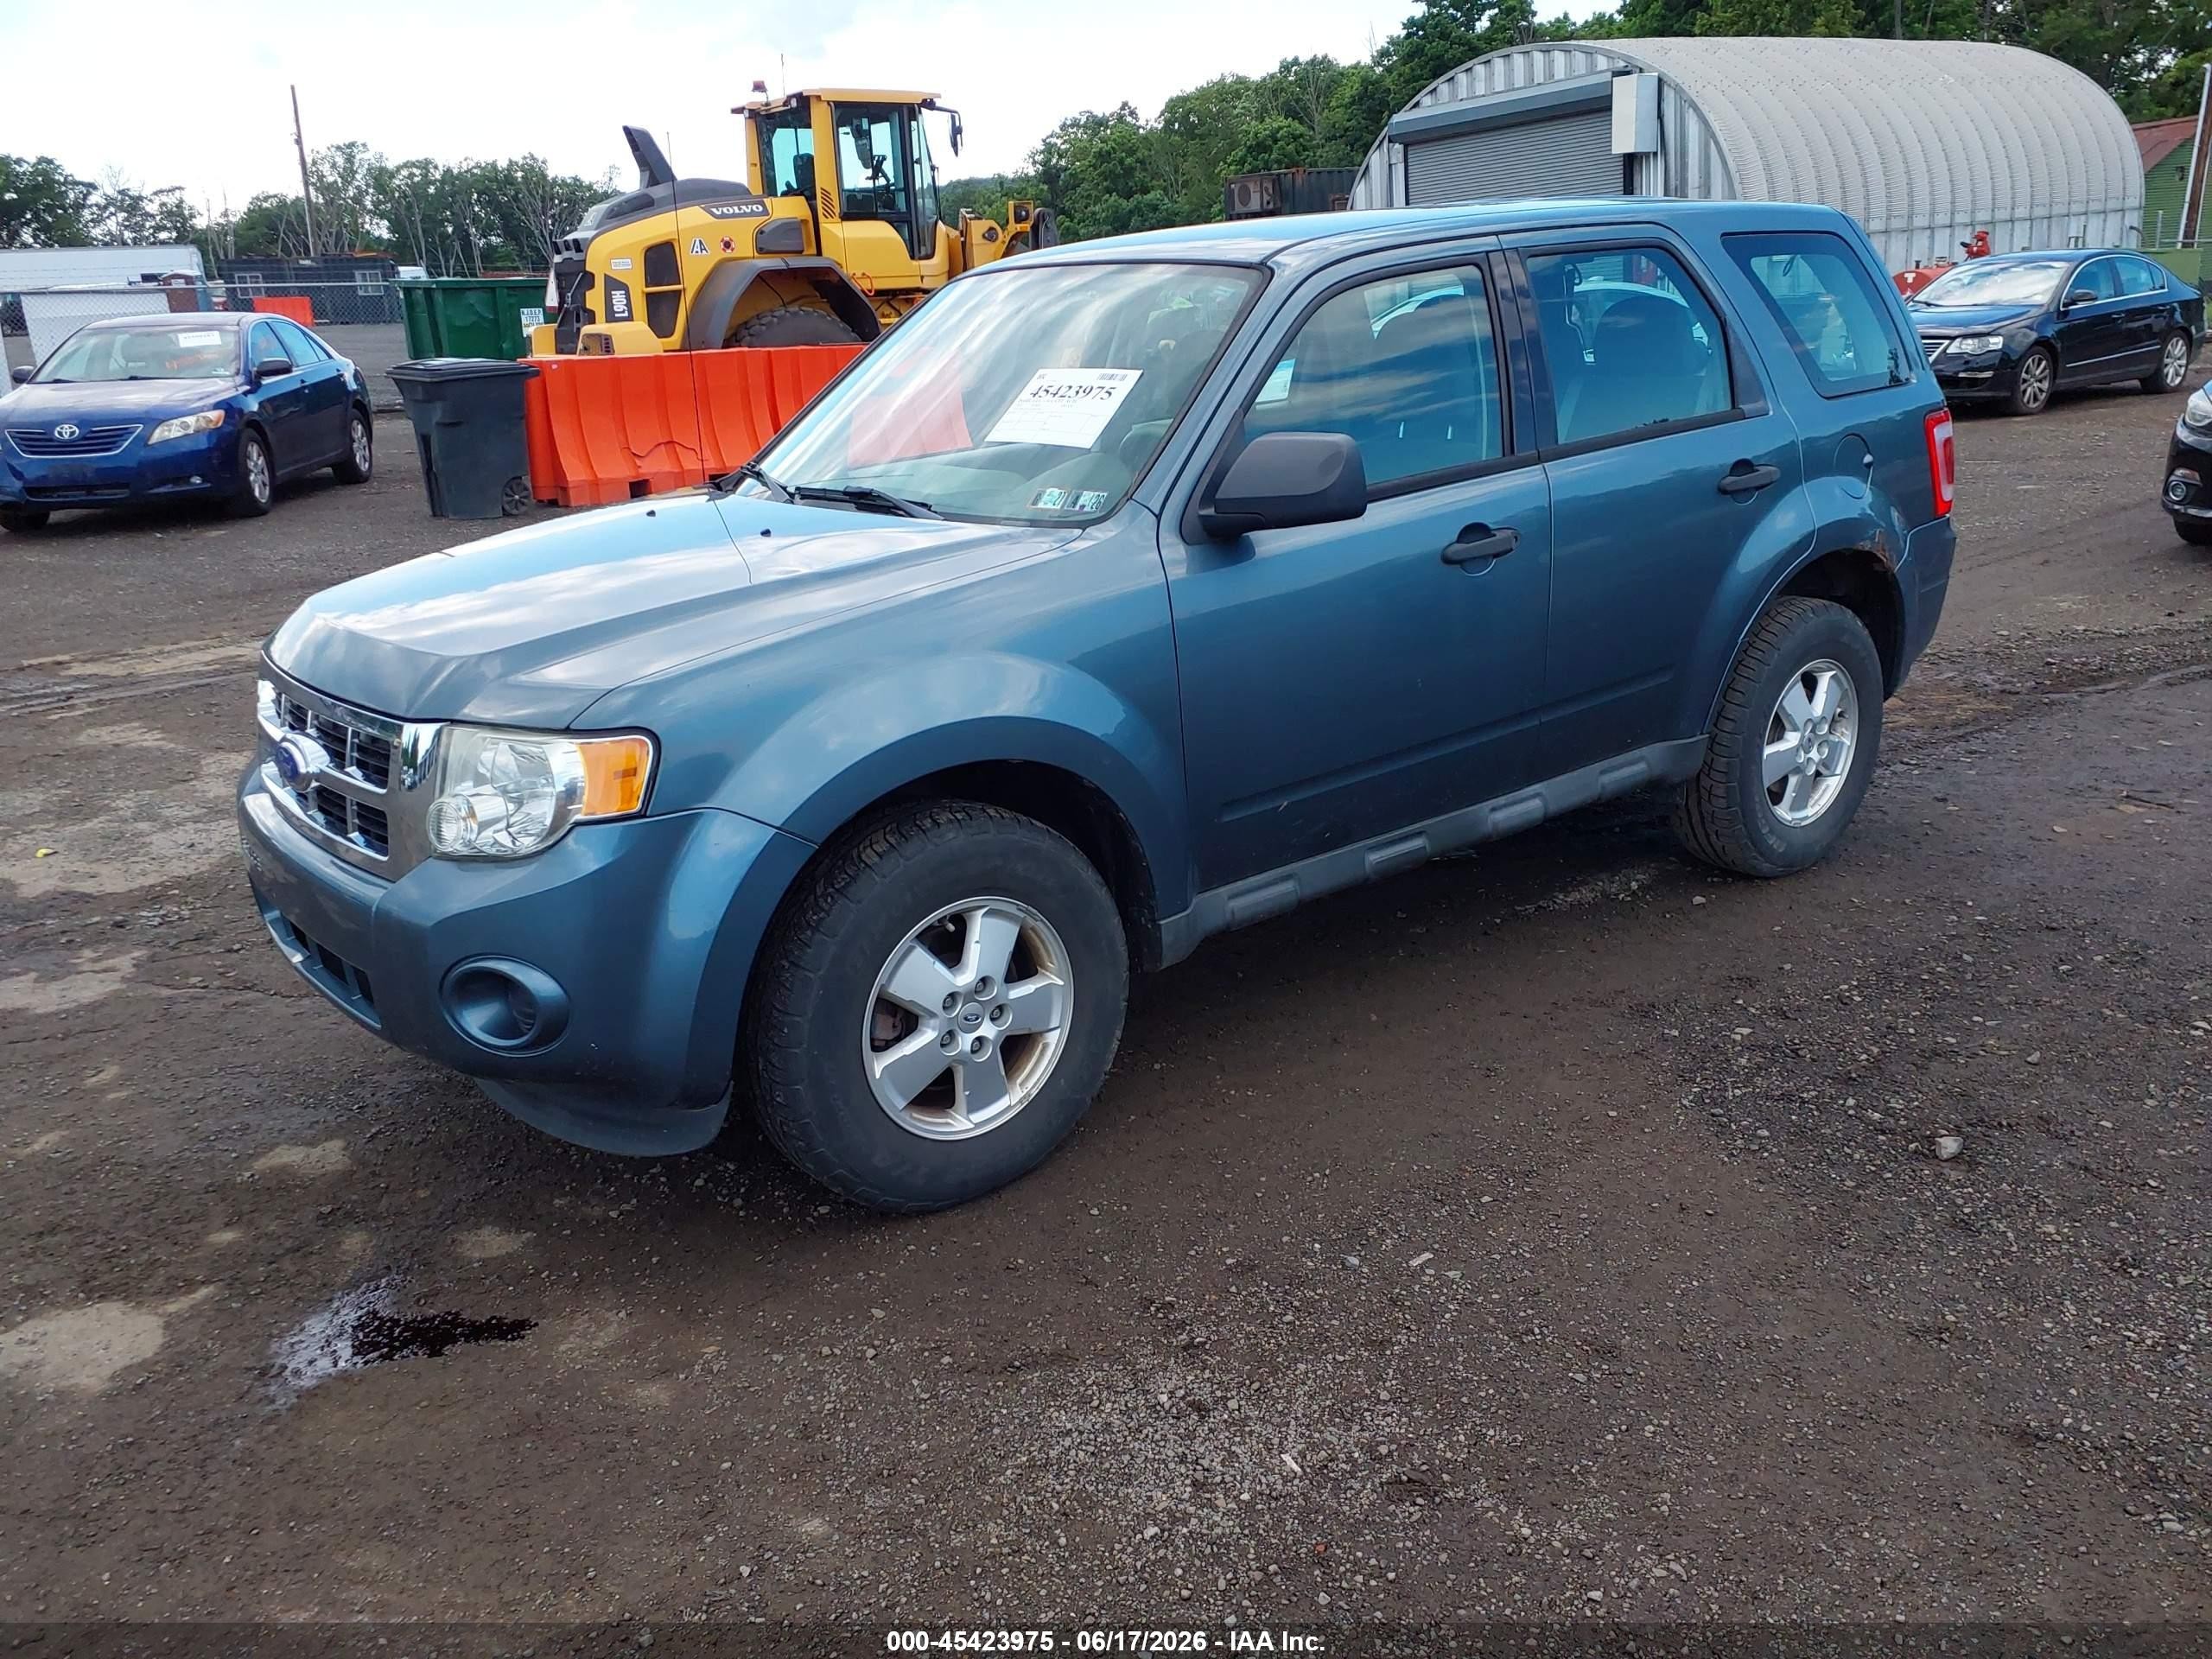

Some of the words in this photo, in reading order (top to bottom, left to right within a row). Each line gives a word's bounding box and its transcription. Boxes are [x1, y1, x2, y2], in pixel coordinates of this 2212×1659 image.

[709, 204, 764, 216] VOLVO
[610, 290, 629, 317] L90H
[1029, 385, 1117, 401] 45423975
